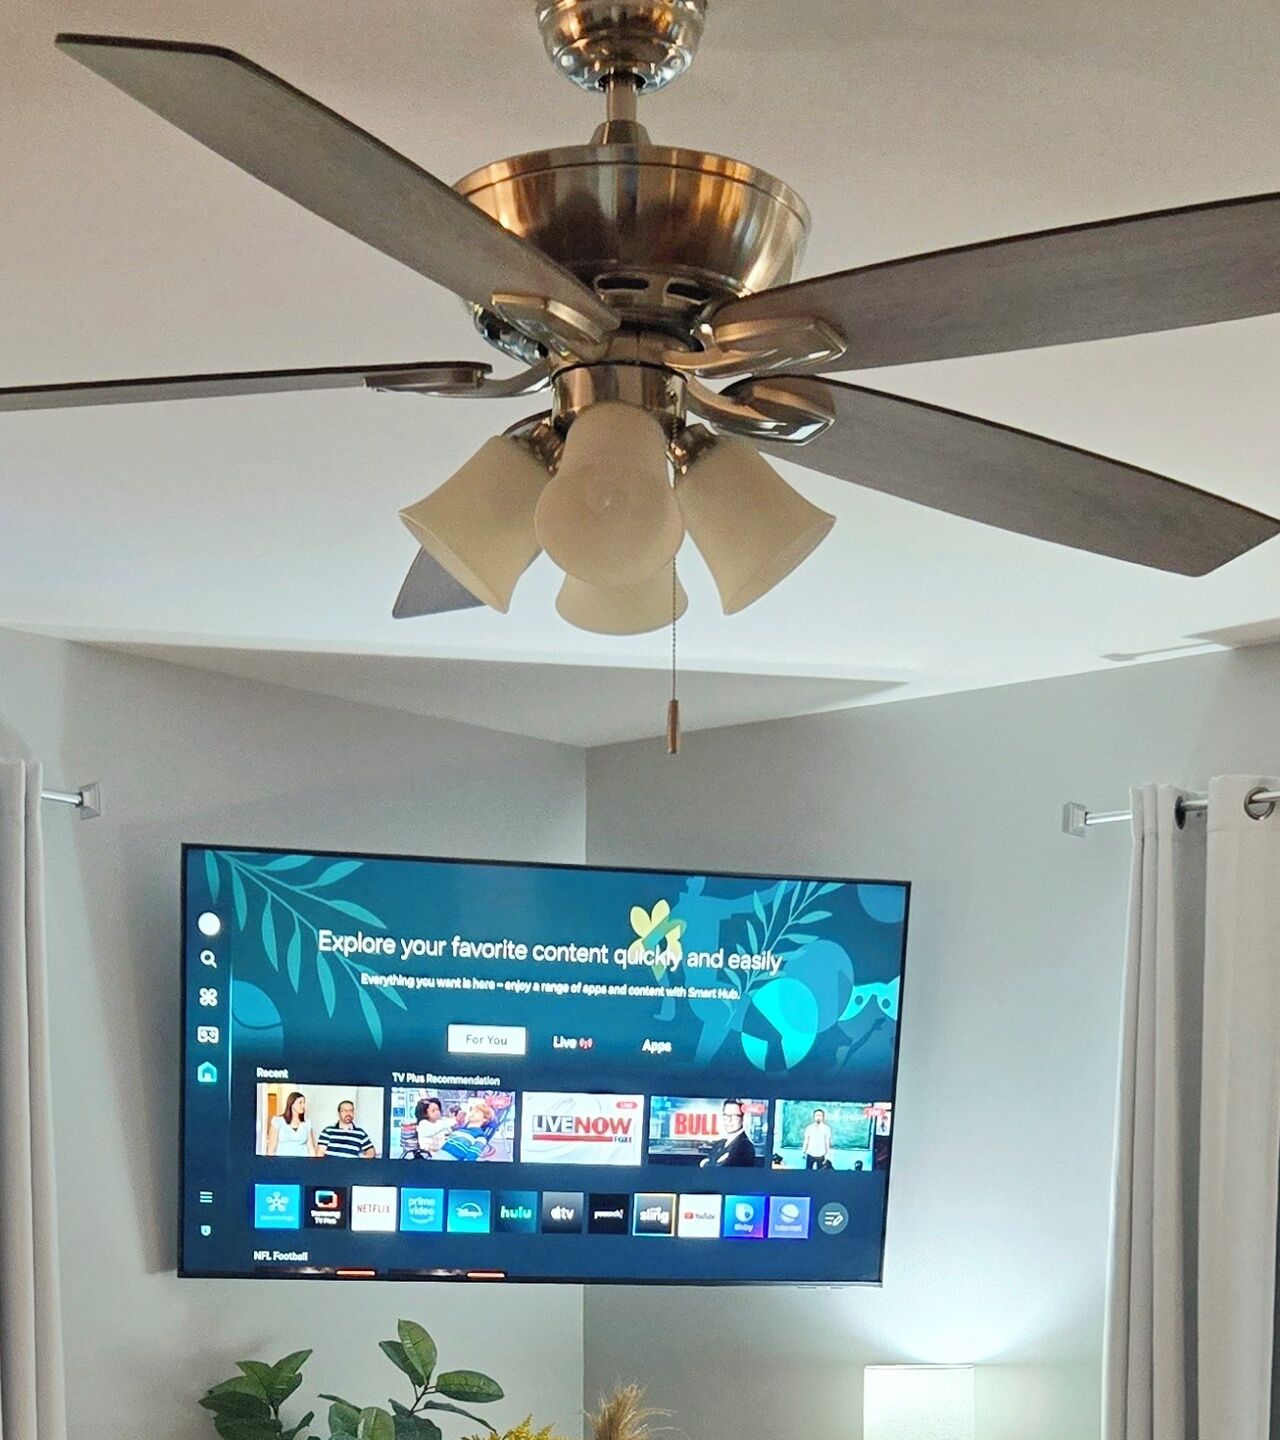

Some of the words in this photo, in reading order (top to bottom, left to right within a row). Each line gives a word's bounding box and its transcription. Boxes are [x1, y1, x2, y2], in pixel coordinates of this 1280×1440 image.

[318, 929, 396, 957] Explore
[400, 937, 447, 960] your
[451, 935, 528, 960] favorite
[532, 942, 608, 964] content
[613, 944, 683, 971] quickly
[686, 948, 724, 970] and
[727, 949, 784, 976] easily
[361, 972, 415, 989] Everything
[416, 977, 435, 990] you
[437, 977, 461, 989] want
[463, 977, 471, 989] is
[472, 978, 495, 990] here
[505, 979, 531, 993] enjoy
[541, 982, 569, 995] range
[570, 981, 582, 994] of
[582, 984, 607, 997] apps
[608, 982, 627, 996] and
[628, 985, 665, 997] content
[666, 985, 687, 998] with
[687, 986, 717, 999] Smart
[466, 1035, 484, 1045] For
[486, 1036, 508, 1046] You
[553, 1036, 577, 1049] Live
[642, 1038, 672, 1053] Apps
[256, 1067, 289, 1079] Recent
[392, 1072, 406, 1083] TV
[407, 1073, 425, 1084] Plus
[426, 1074, 501, 1086] Recommendation
[674, 1112, 719, 1136] BULL
[357, 1204, 391, 1214] NETFLIX
[500, 1205, 532, 1219] hulu
[253, 1251, 271, 1261] NFL
[273, 1251, 308, 1262] Football
